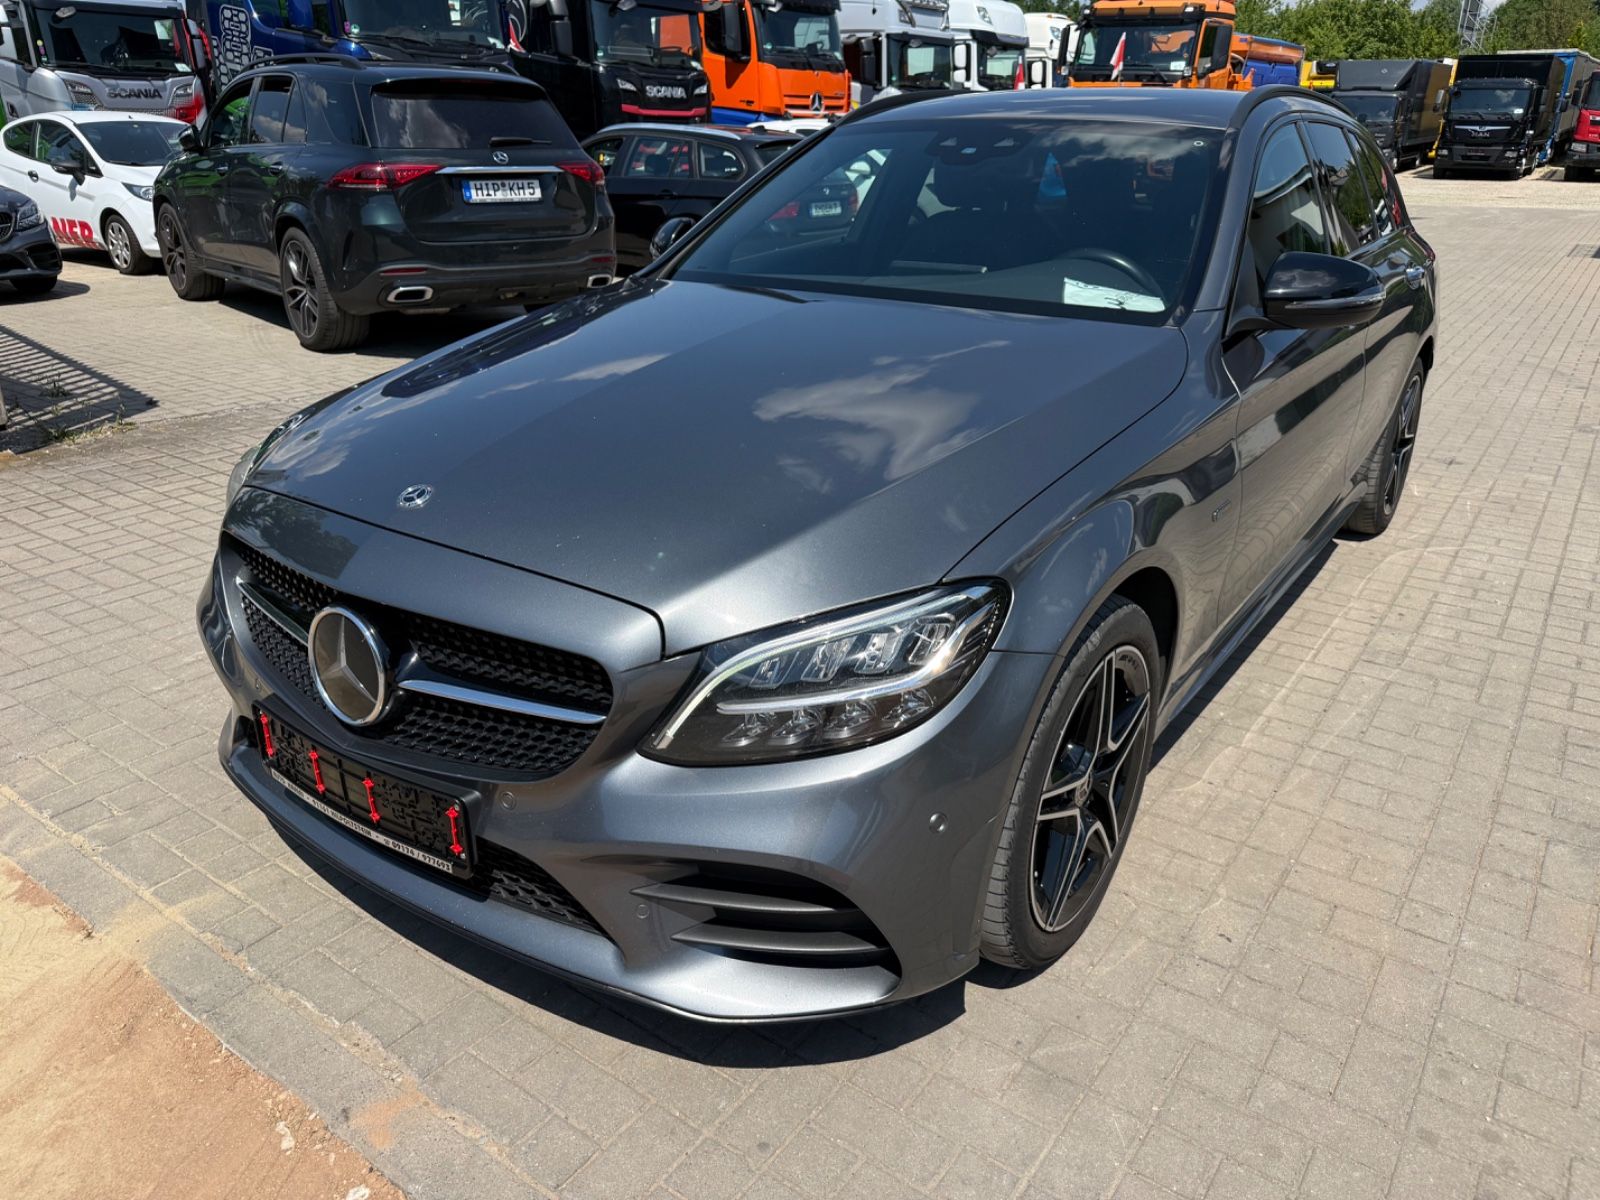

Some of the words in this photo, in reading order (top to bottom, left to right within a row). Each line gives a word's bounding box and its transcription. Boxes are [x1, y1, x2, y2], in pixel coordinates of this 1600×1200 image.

[106, 87, 162, 99] SCANIA
[646, 86, 687, 99] SCANIA
[474, 183, 501, 197] HIP
